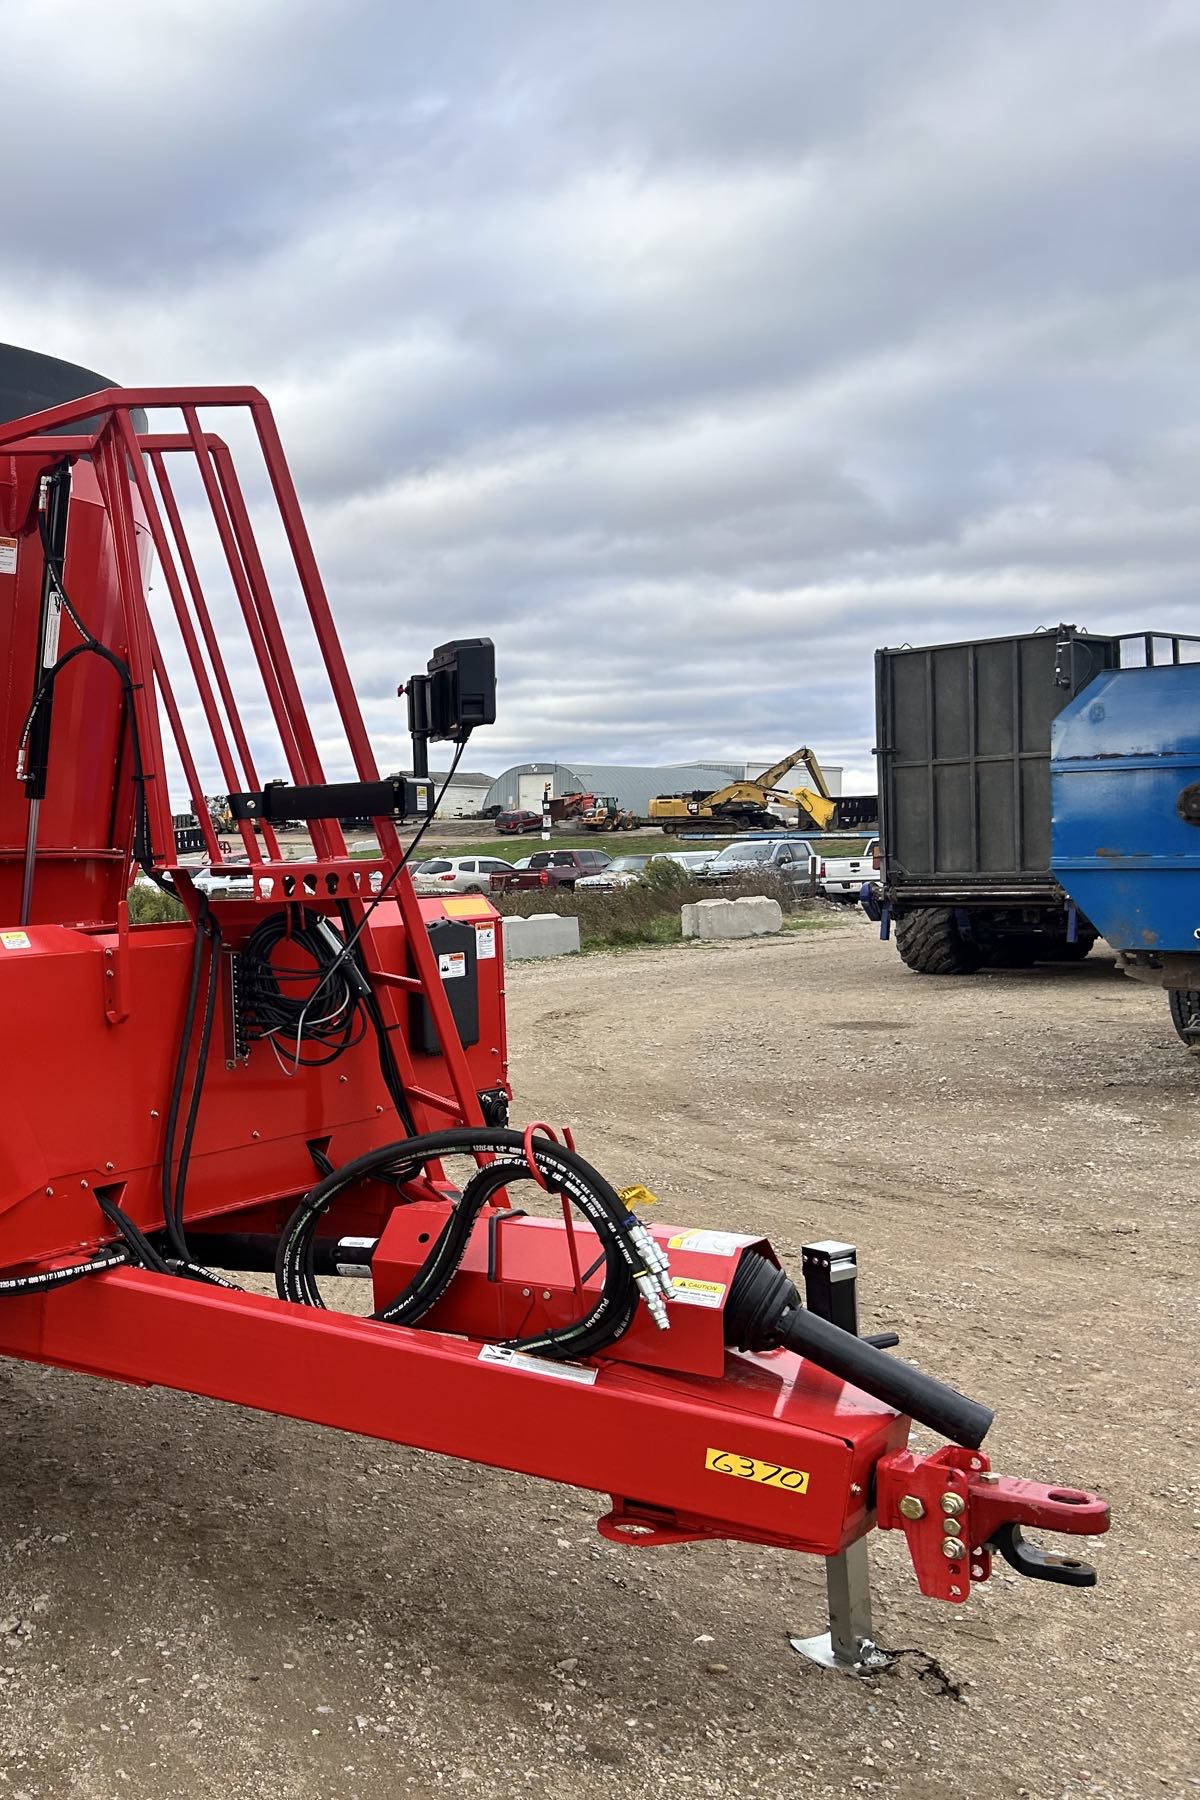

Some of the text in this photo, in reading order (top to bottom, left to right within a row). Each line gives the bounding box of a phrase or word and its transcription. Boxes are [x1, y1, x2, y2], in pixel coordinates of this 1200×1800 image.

[564, 1180, 582, 1197] MADE
[579, 1194, 589, 1204] IN
[585, 1202, 600, 1218] ITALY
[688, 1282, 718, 1291] CAUTION
[585, 1297, 610, 1328] PULSAR
[711, 1453, 805, 1489] 6370
